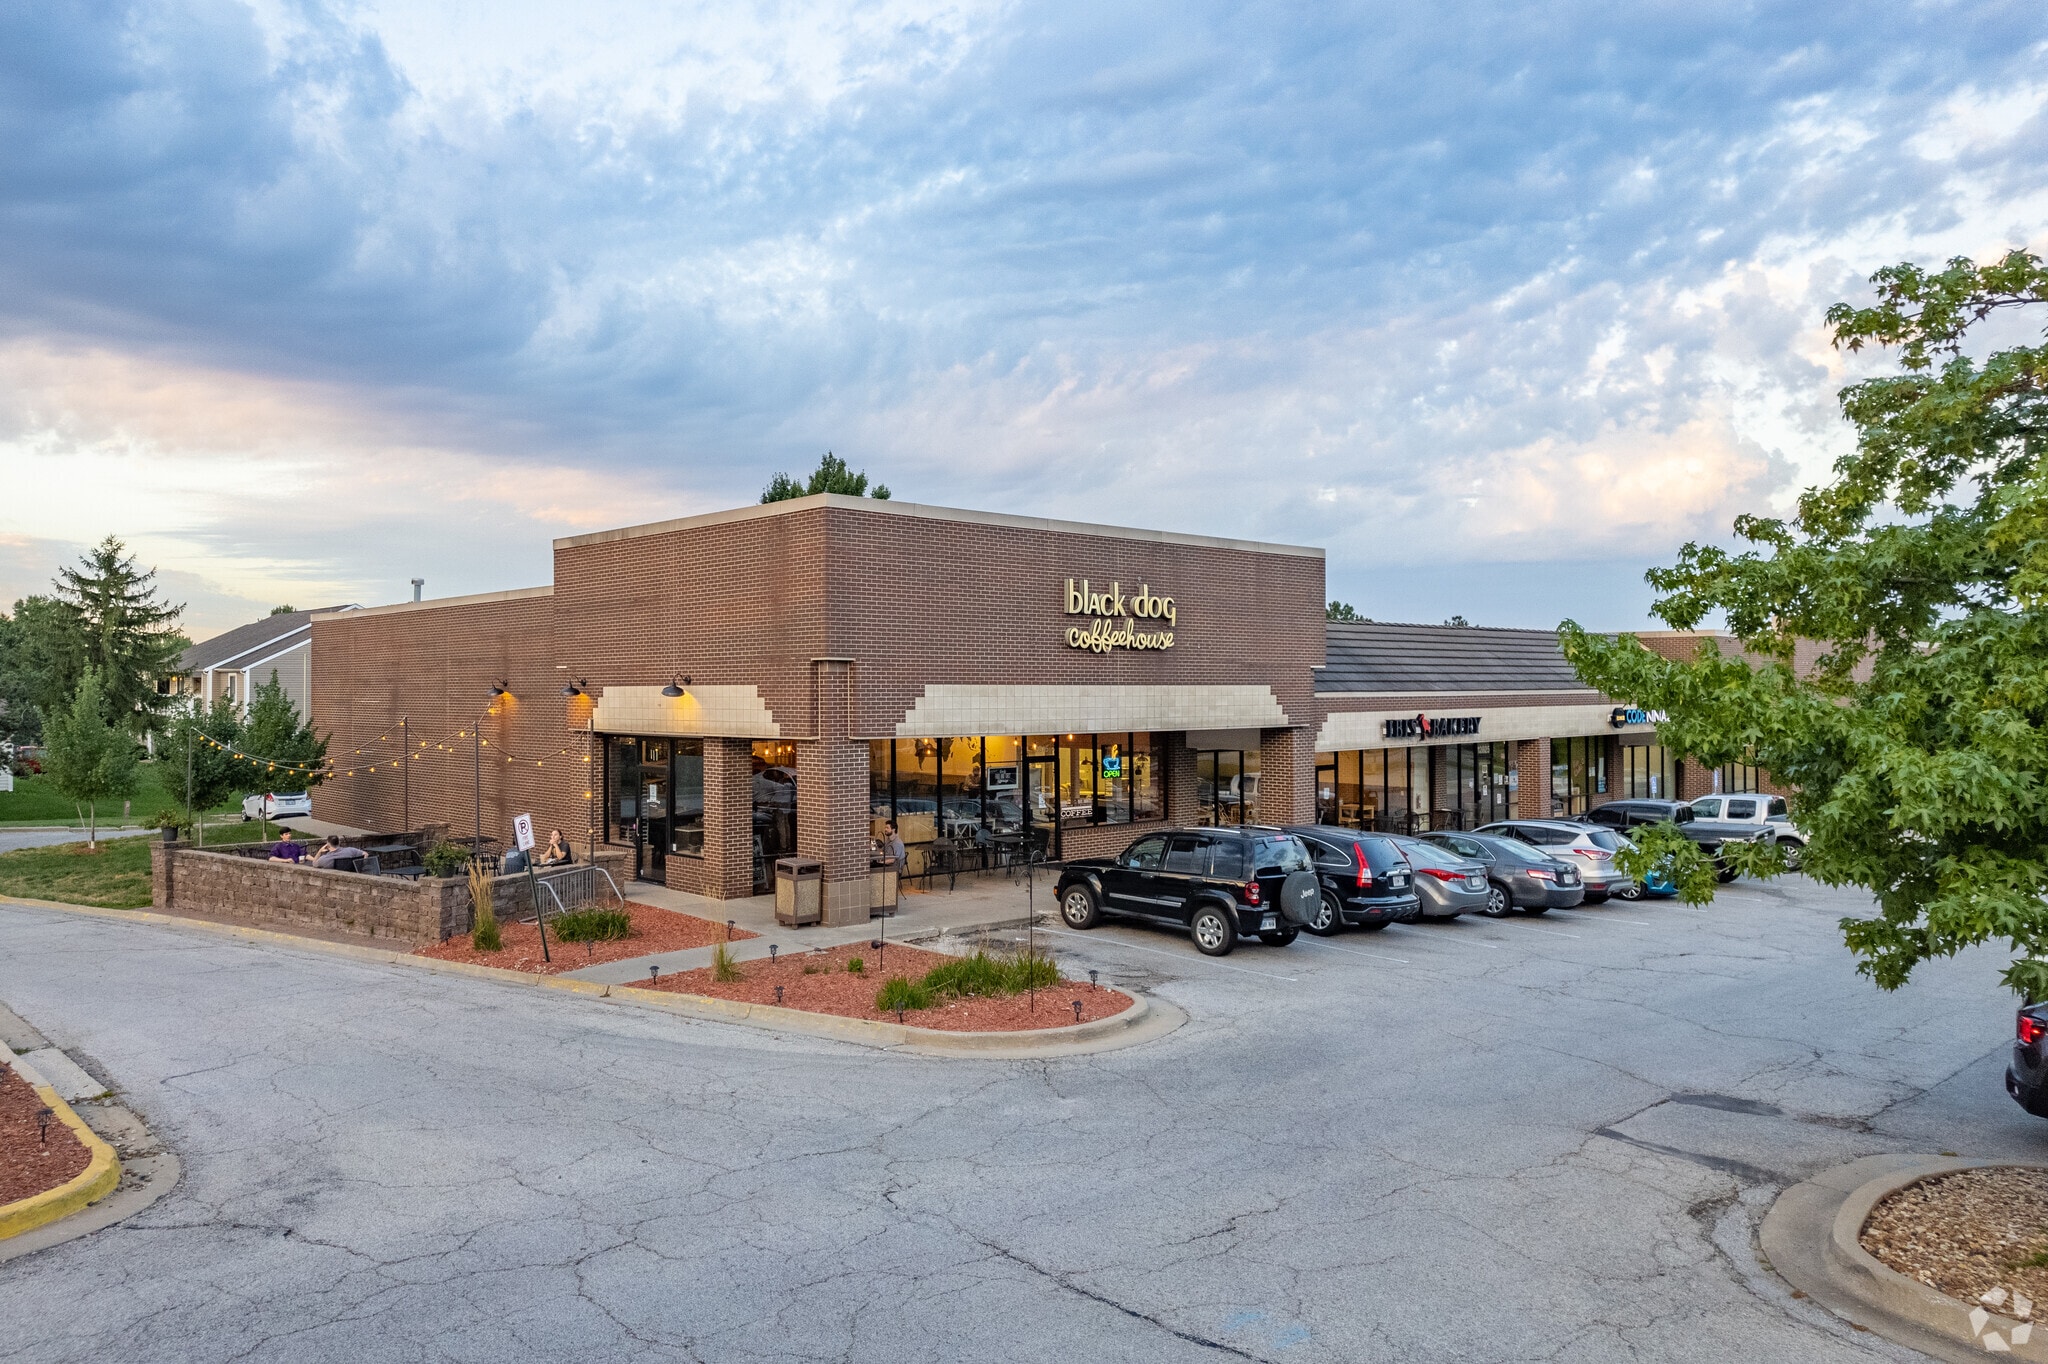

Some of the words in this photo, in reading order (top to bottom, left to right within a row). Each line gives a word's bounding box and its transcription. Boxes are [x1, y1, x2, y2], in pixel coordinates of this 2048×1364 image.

[1064, 578, 1126, 616] black
[1130, 583, 1176, 627] dog
[1065, 618, 1175, 653] coffeehouse
[1429, 717, 1482, 737] BAKERY
[1103, 770, 1120, 778] OPEN
[1060, 809, 1093, 818] COFFEE
[1301, 888, 1315, 899] Jeep
